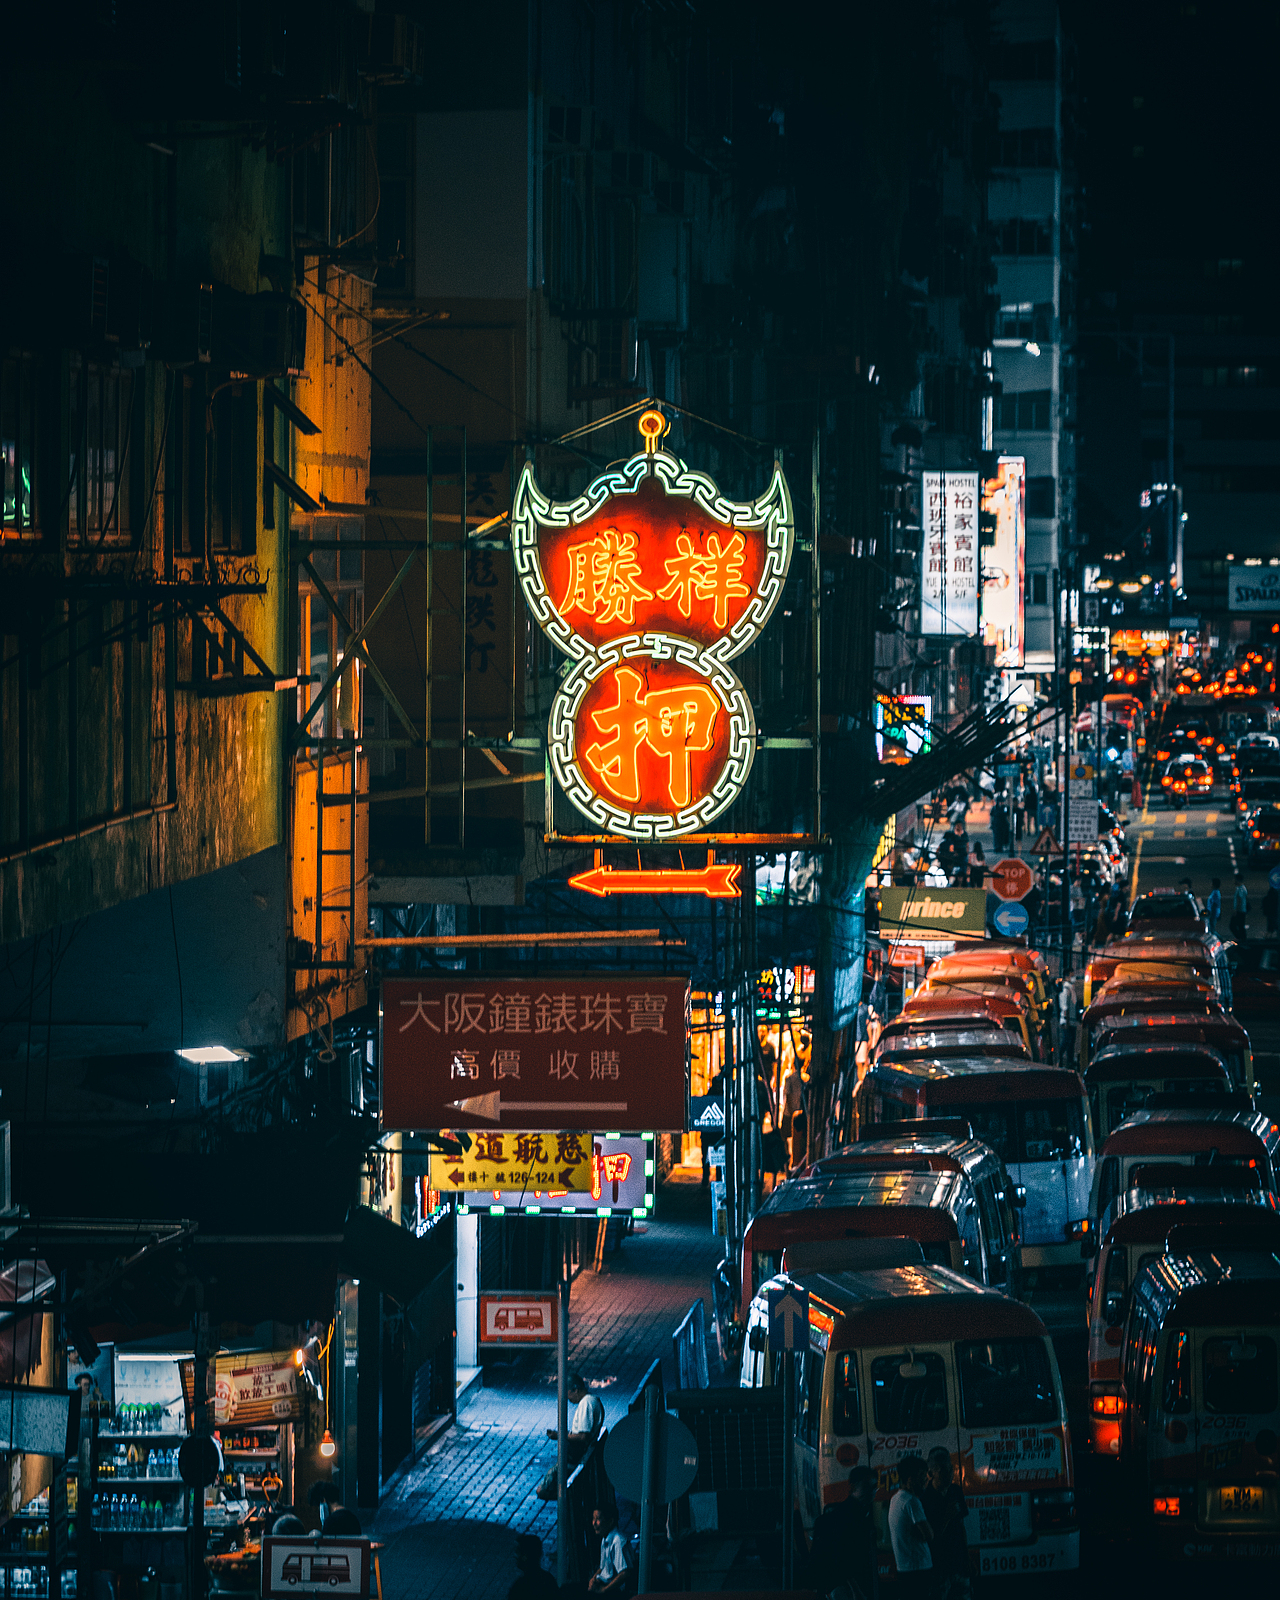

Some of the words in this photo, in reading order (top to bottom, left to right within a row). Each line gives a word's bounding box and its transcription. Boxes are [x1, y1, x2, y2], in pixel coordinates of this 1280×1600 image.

[949, 478, 976, 488] HOSTEL
[954, 492, 973, 573] 裕家賓館
[585, 667, 722, 808] 押
[900, 896, 966, 921] prince
[399, 992, 668, 1035] 大阪鐘錶珠寶
[1202, 1416, 1247, 1429] 2036
[873, 1435, 919, 1450] 2036
[982, 1556, 1016, 1572] 8108
[1021, 1553, 1056, 1569] 8387
